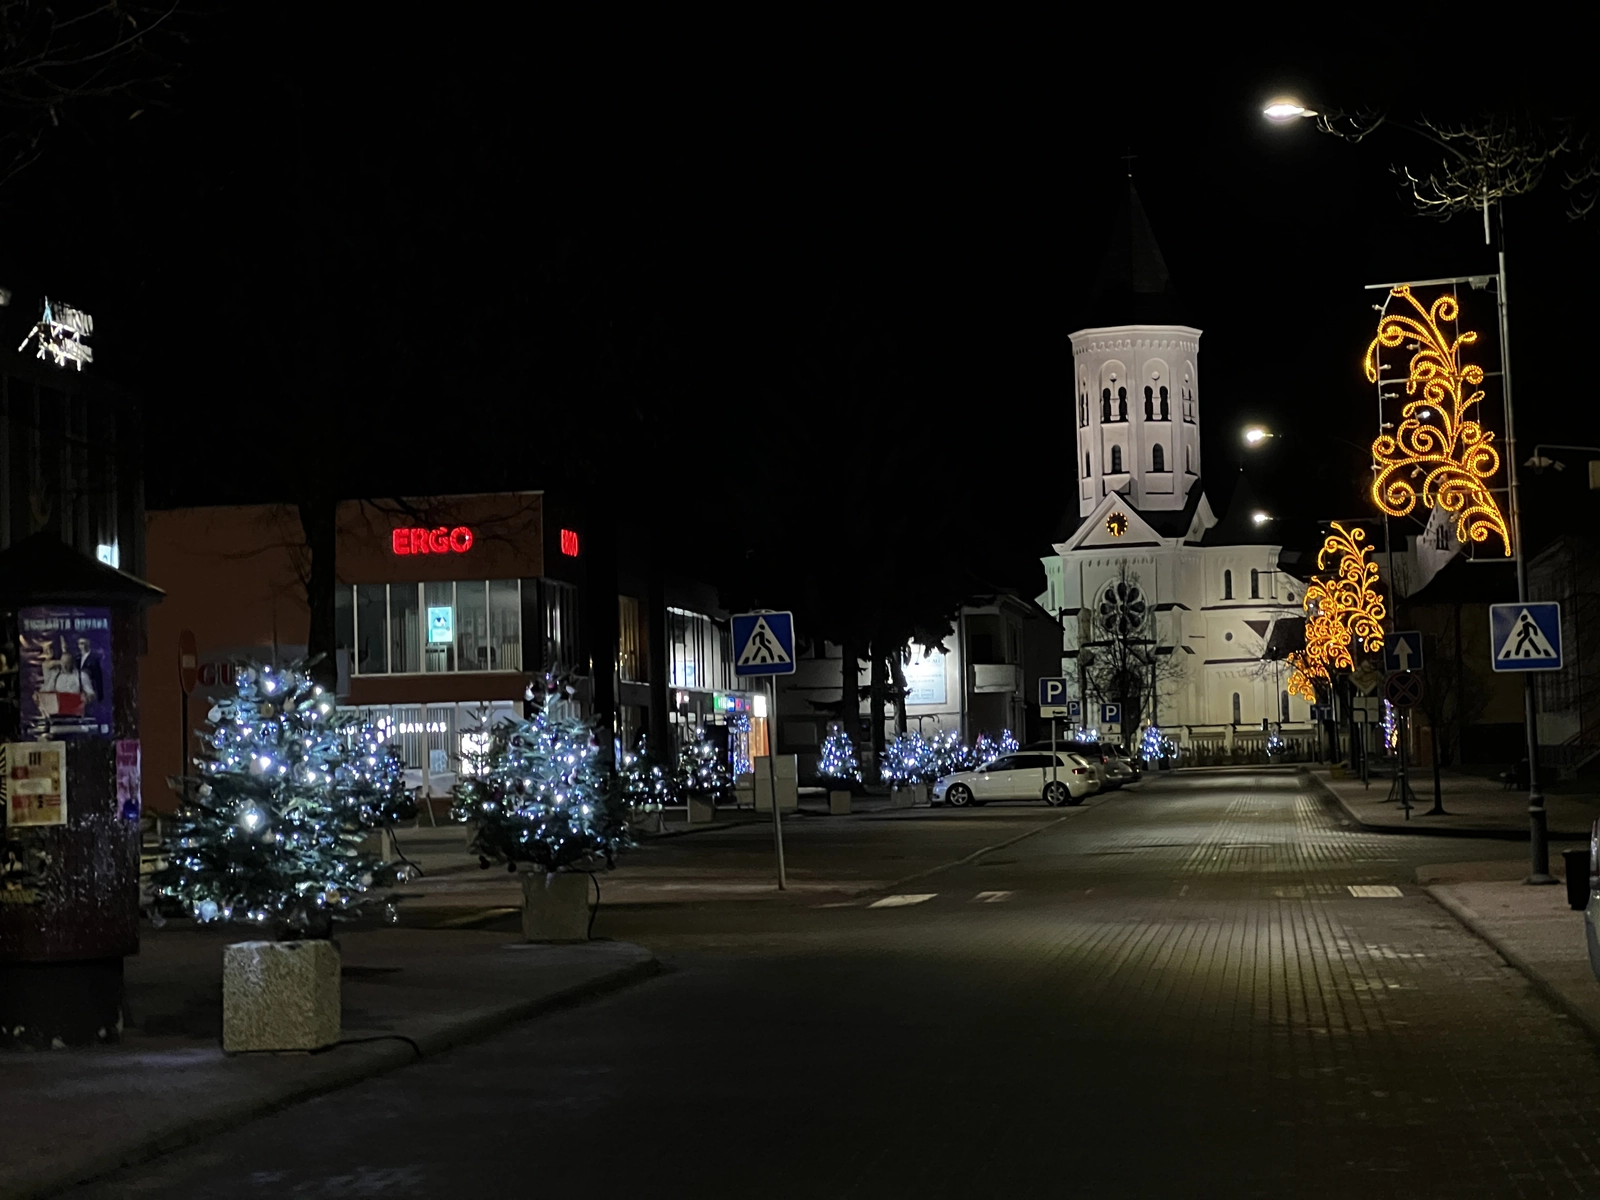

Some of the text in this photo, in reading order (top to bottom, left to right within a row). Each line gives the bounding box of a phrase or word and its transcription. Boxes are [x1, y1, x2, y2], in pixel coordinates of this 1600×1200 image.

[392, 526, 473, 555] ERGO
[1047, 681, 1062, 703] P
[1069, 702, 1078, 716] P
[1106, 705, 1117, 721] P
